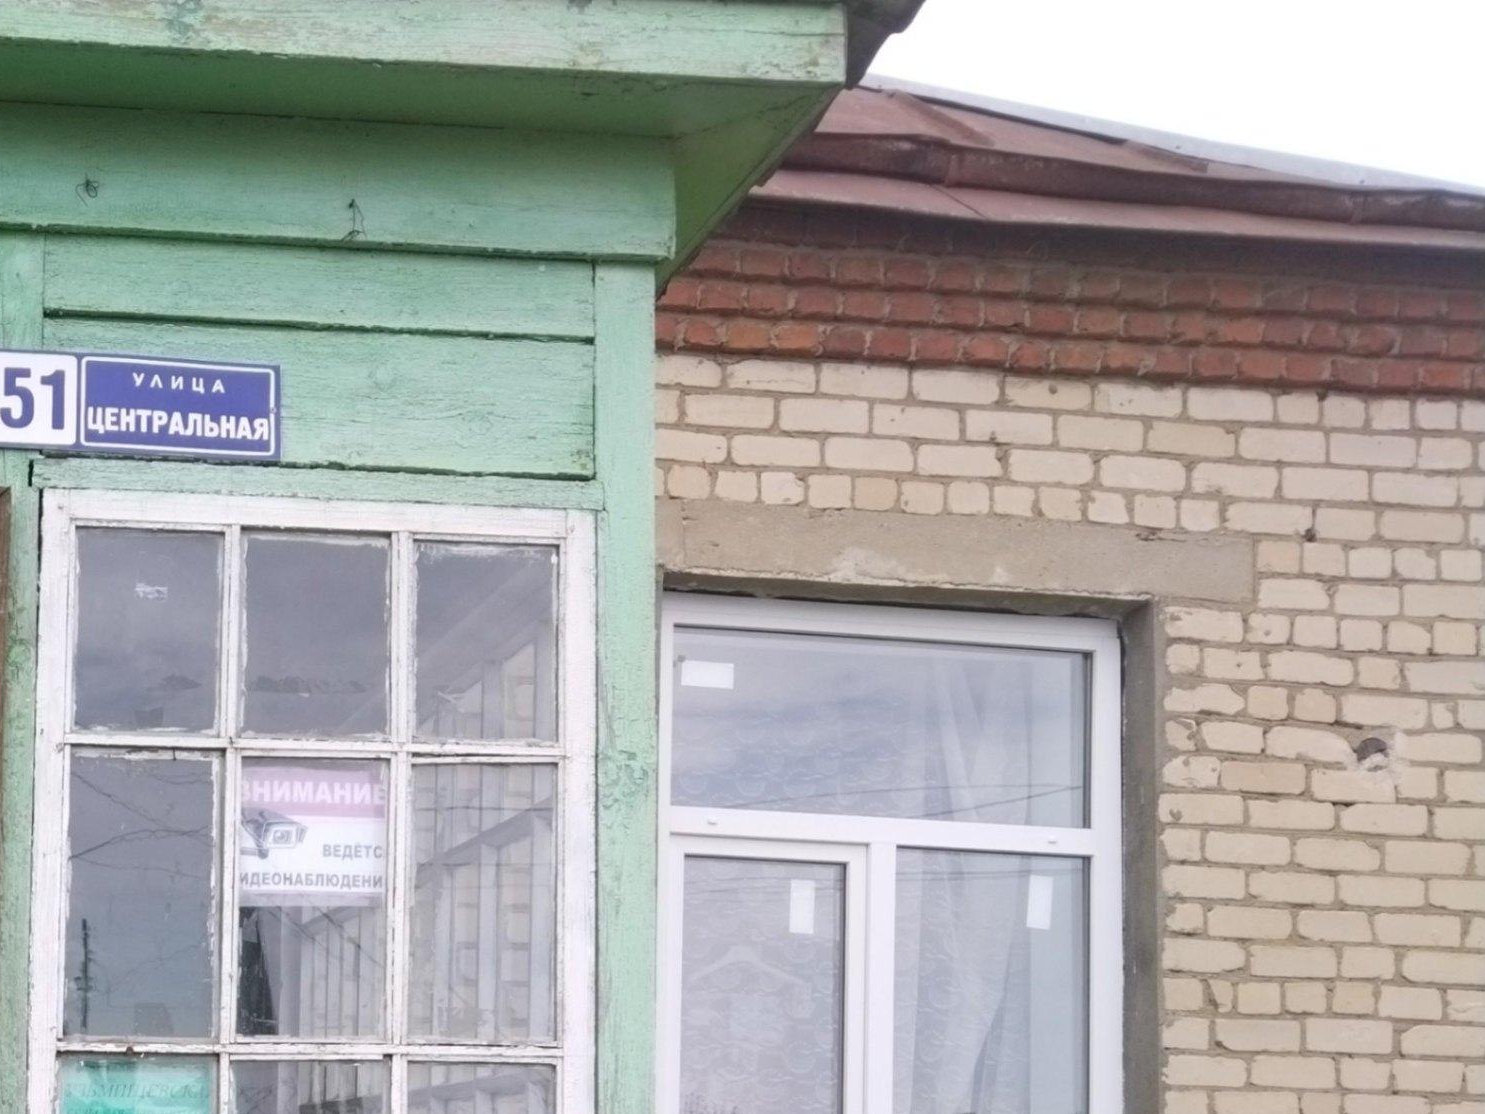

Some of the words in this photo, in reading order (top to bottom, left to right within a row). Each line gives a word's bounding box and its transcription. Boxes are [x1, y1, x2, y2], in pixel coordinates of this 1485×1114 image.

[132, 372, 225, 393] УЛИЦА
[0, 367, 66, 431] 51
[87, 406, 269, 441] ЦЕНТРАЛЬНАЯ
[240, 872, 383, 889] ИДЕОНАБЛЮДЕНИ
